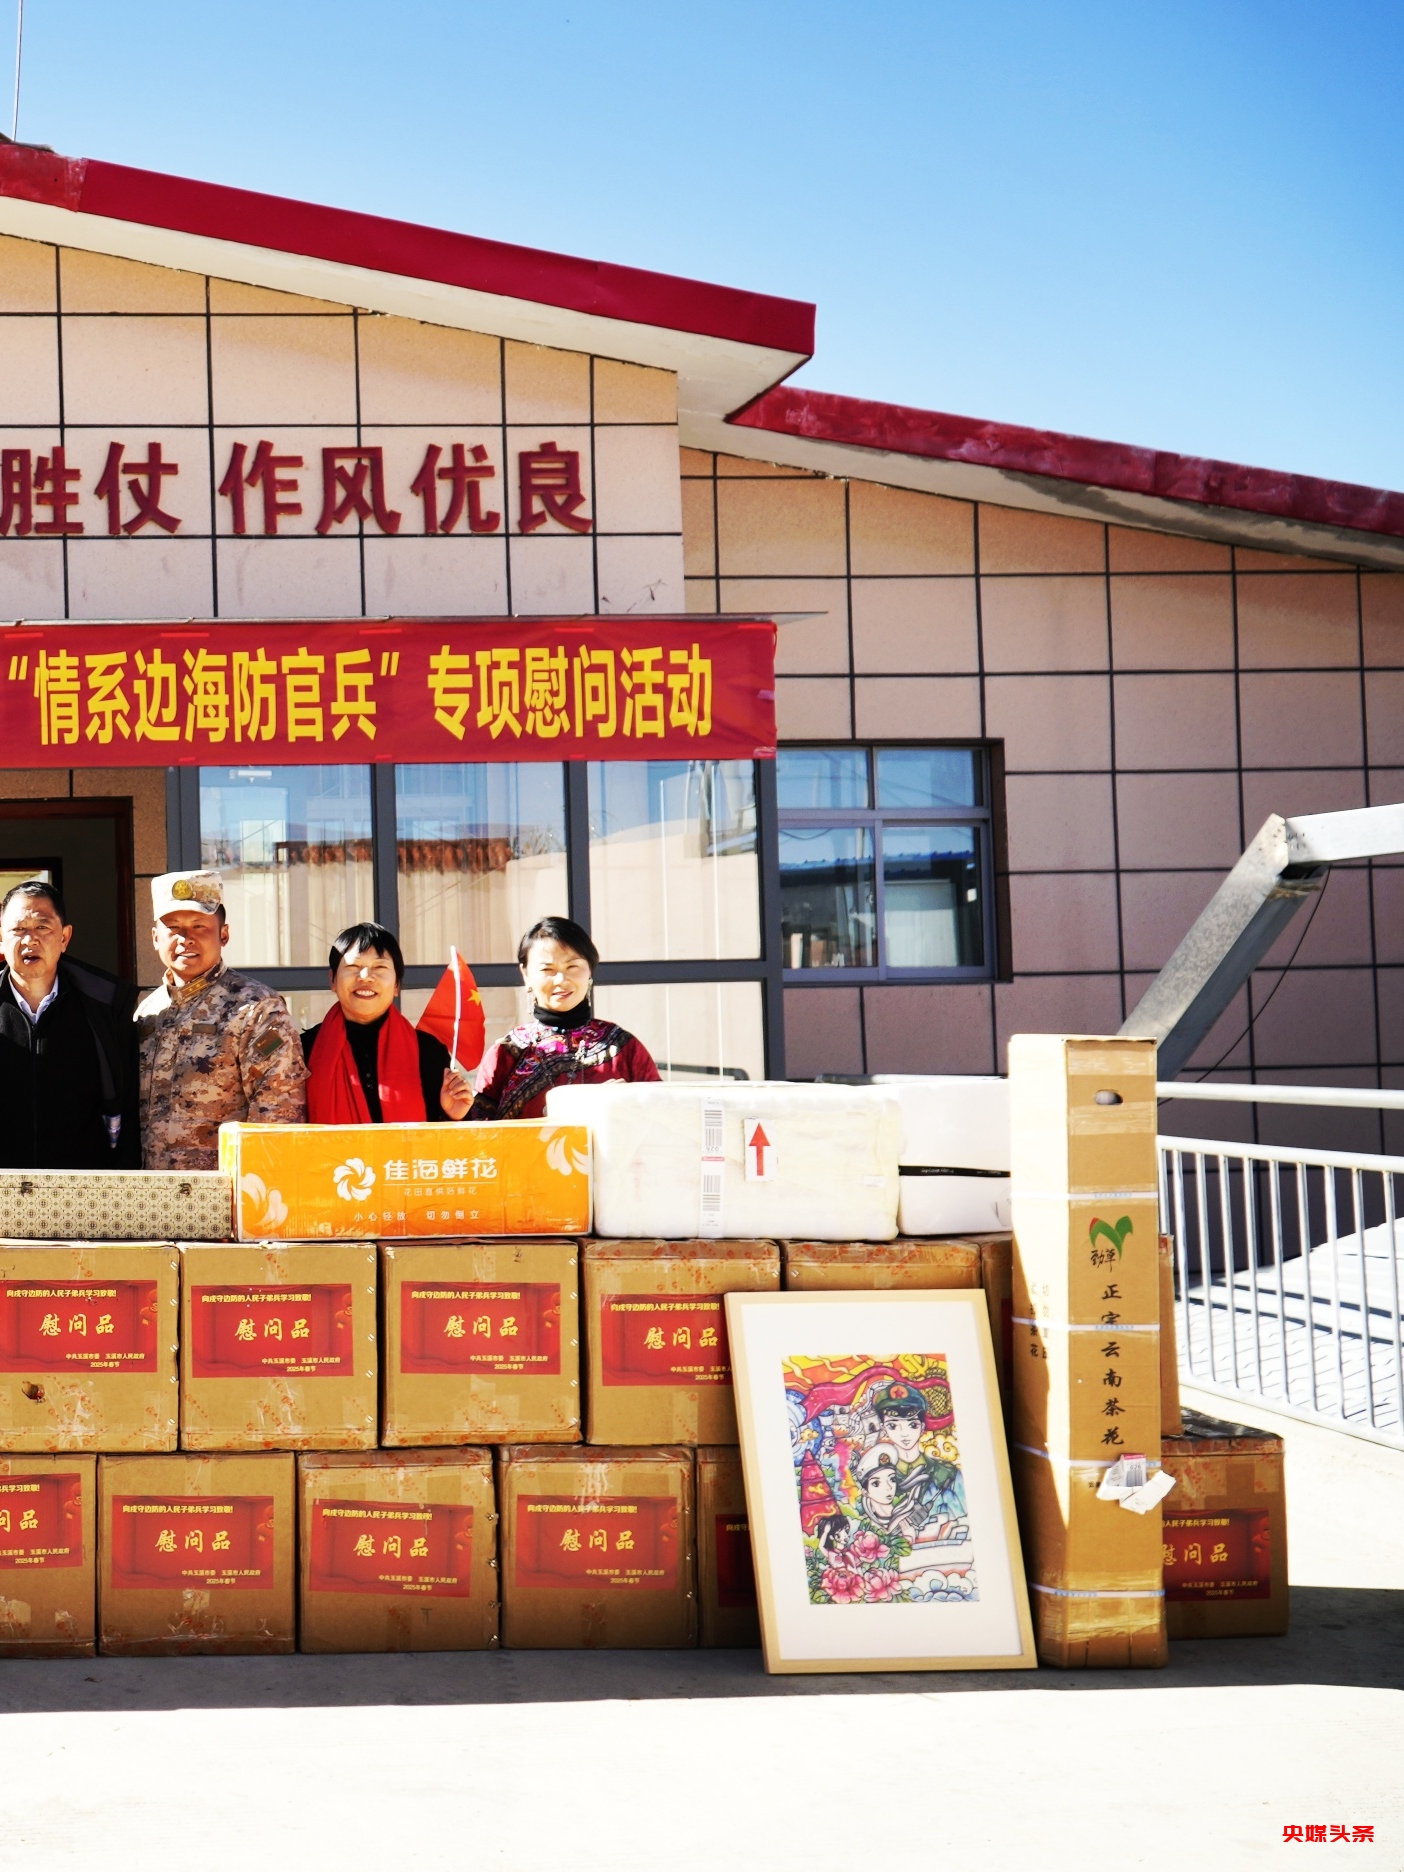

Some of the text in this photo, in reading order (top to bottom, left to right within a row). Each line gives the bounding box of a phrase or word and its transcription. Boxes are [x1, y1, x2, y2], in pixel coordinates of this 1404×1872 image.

[218, 440, 595, 536] 作风优良
[383, 1157, 498, 1181] 佳海鲜花
[403, 1186, 478, 1197] 花田直供好鲜花
[354, 1209, 480, 1222] 小心轻放 切勿倒立
[39, 1314, 114, 1336] 慰问品
[235, 1318, 310, 1341] 慰问品
[444, 1315, 518, 1338] 慰问品
[644, 1327, 718, 1349] 慰问品
[155, 1529, 231, 1552] 慰问品
[353, 1534, 429, 1558] 慰问品
[560, 1528, 635, 1552] 慰问品
